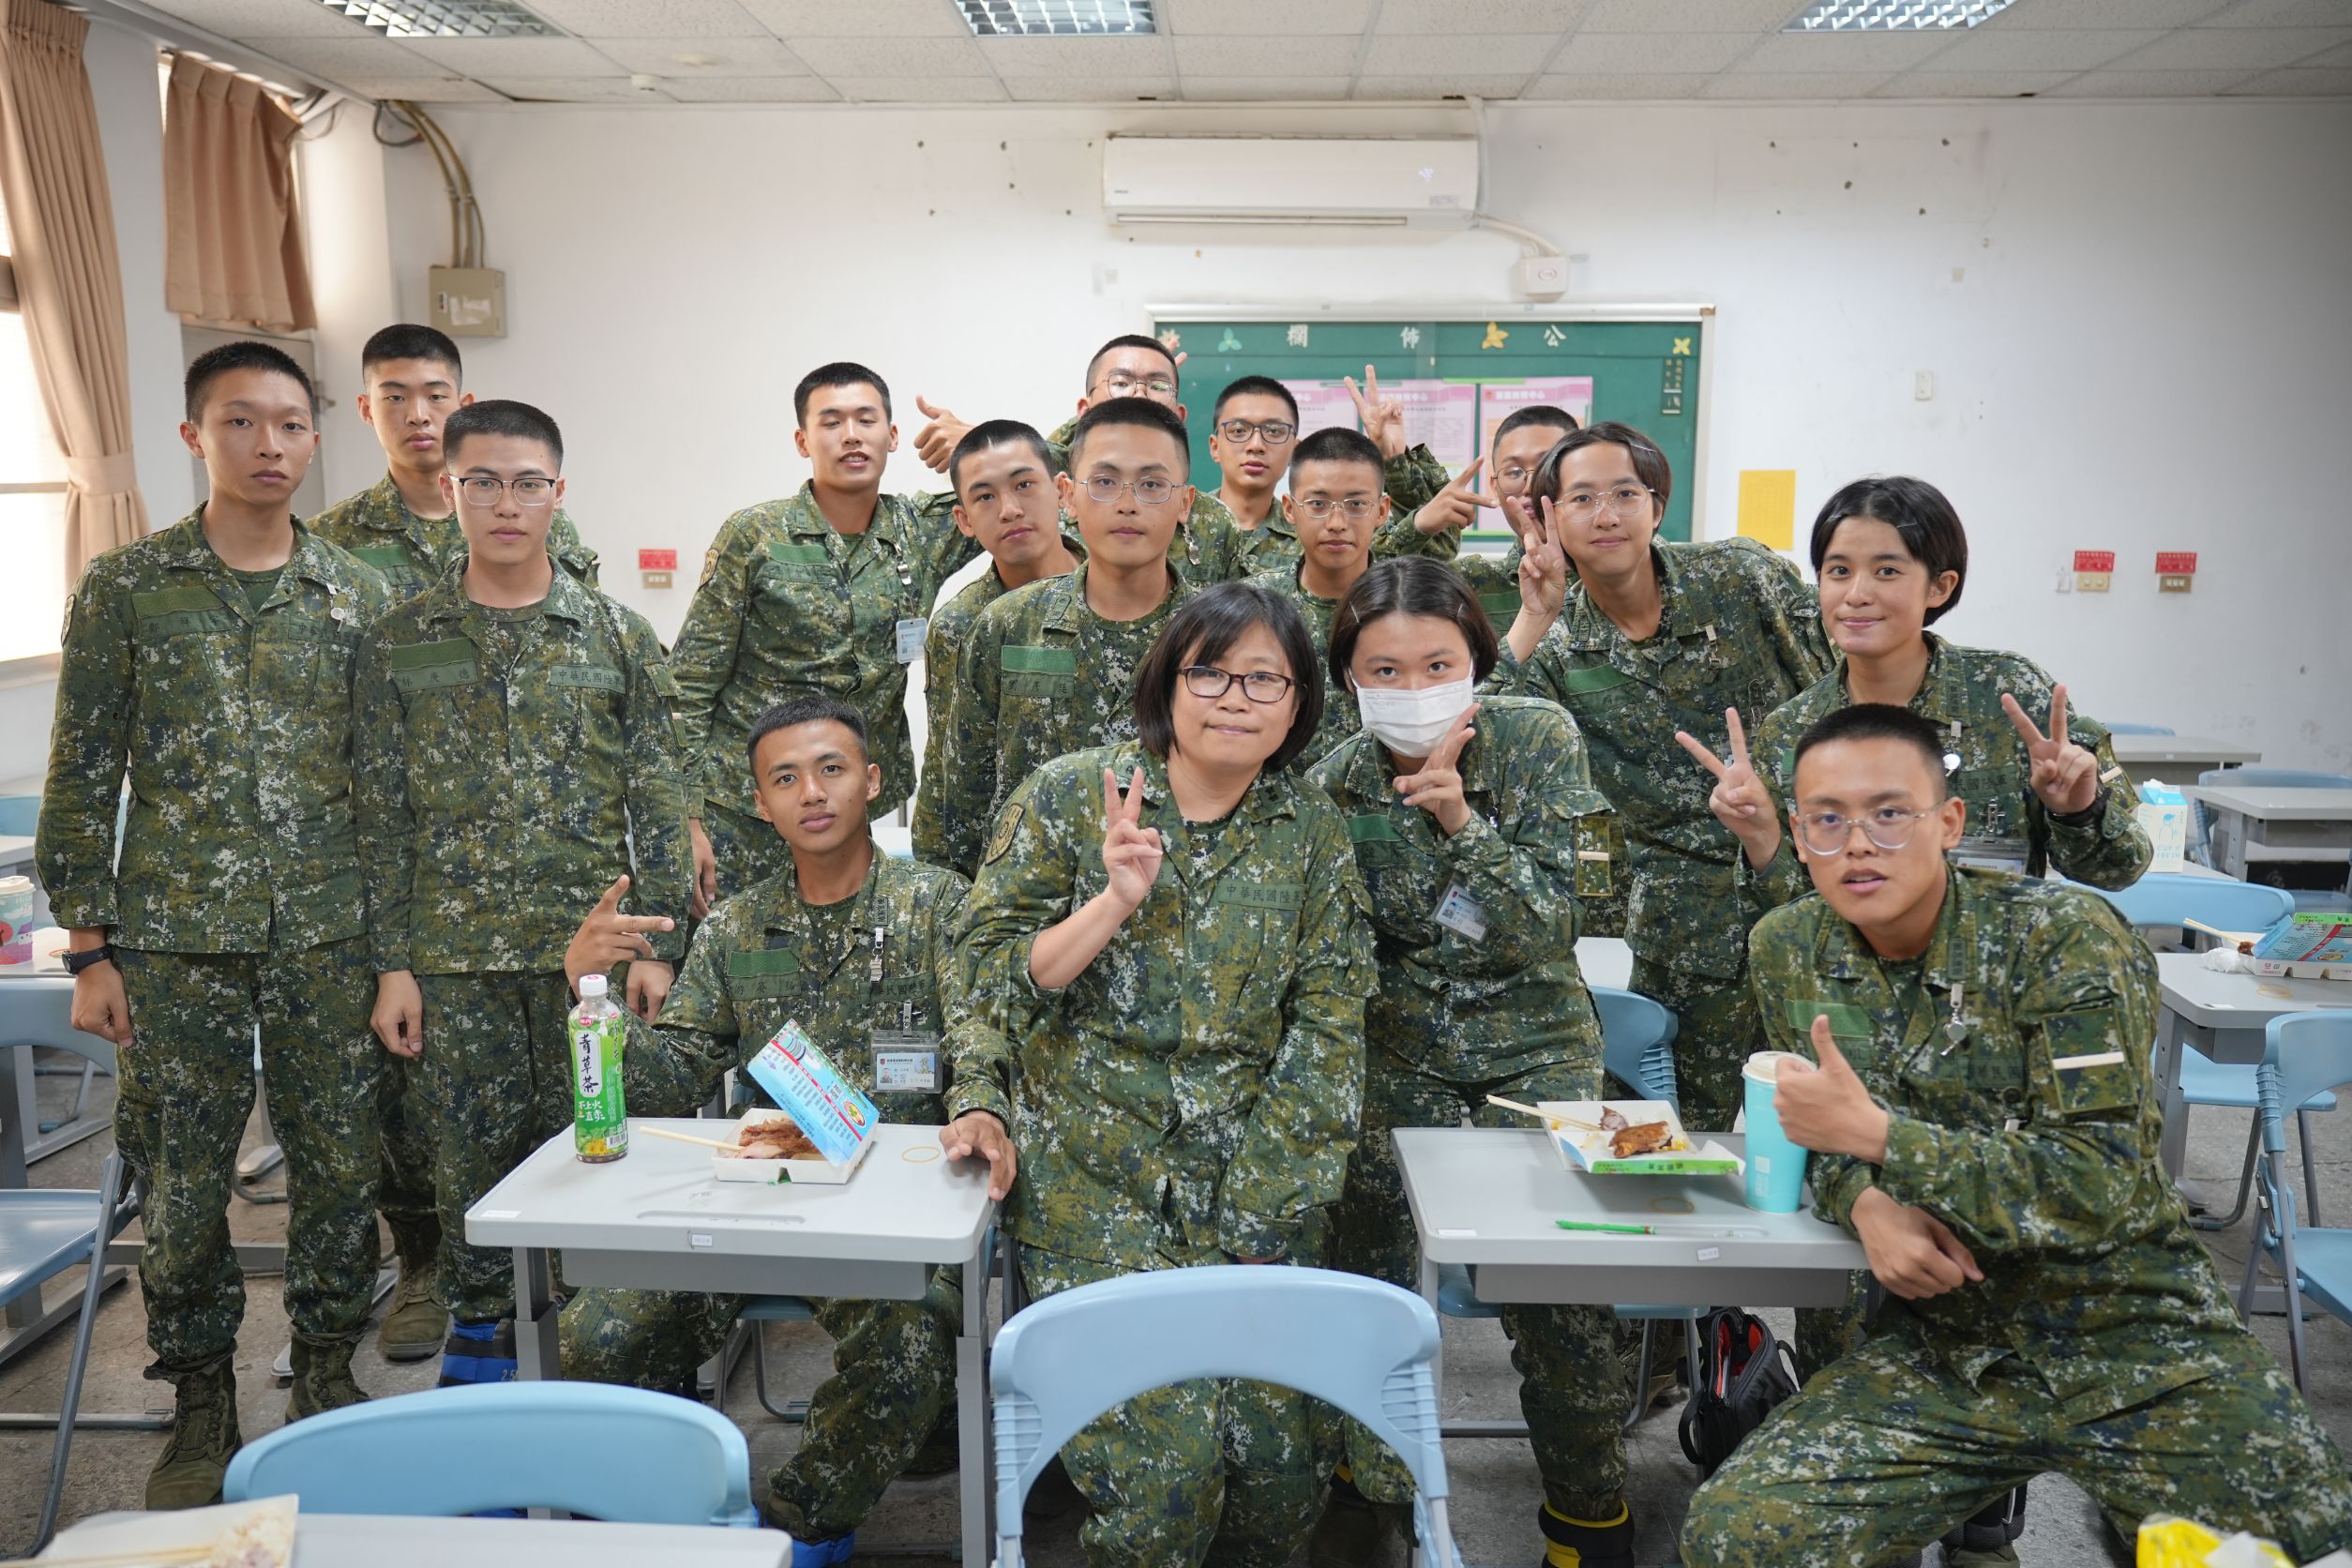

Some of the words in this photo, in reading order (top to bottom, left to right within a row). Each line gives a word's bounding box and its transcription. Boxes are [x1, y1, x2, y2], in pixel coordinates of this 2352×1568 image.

[1287, 324, 1309, 348] 欄
[1544, 324, 1567, 347] 公
[559, 670, 621, 686] 中華民國陸軍
[1227, 883, 1301, 904] 中華民國陸軍
[579, 1033, 599, 1094] 青草茶
[578, 1100, 603, 1109] 不上火
